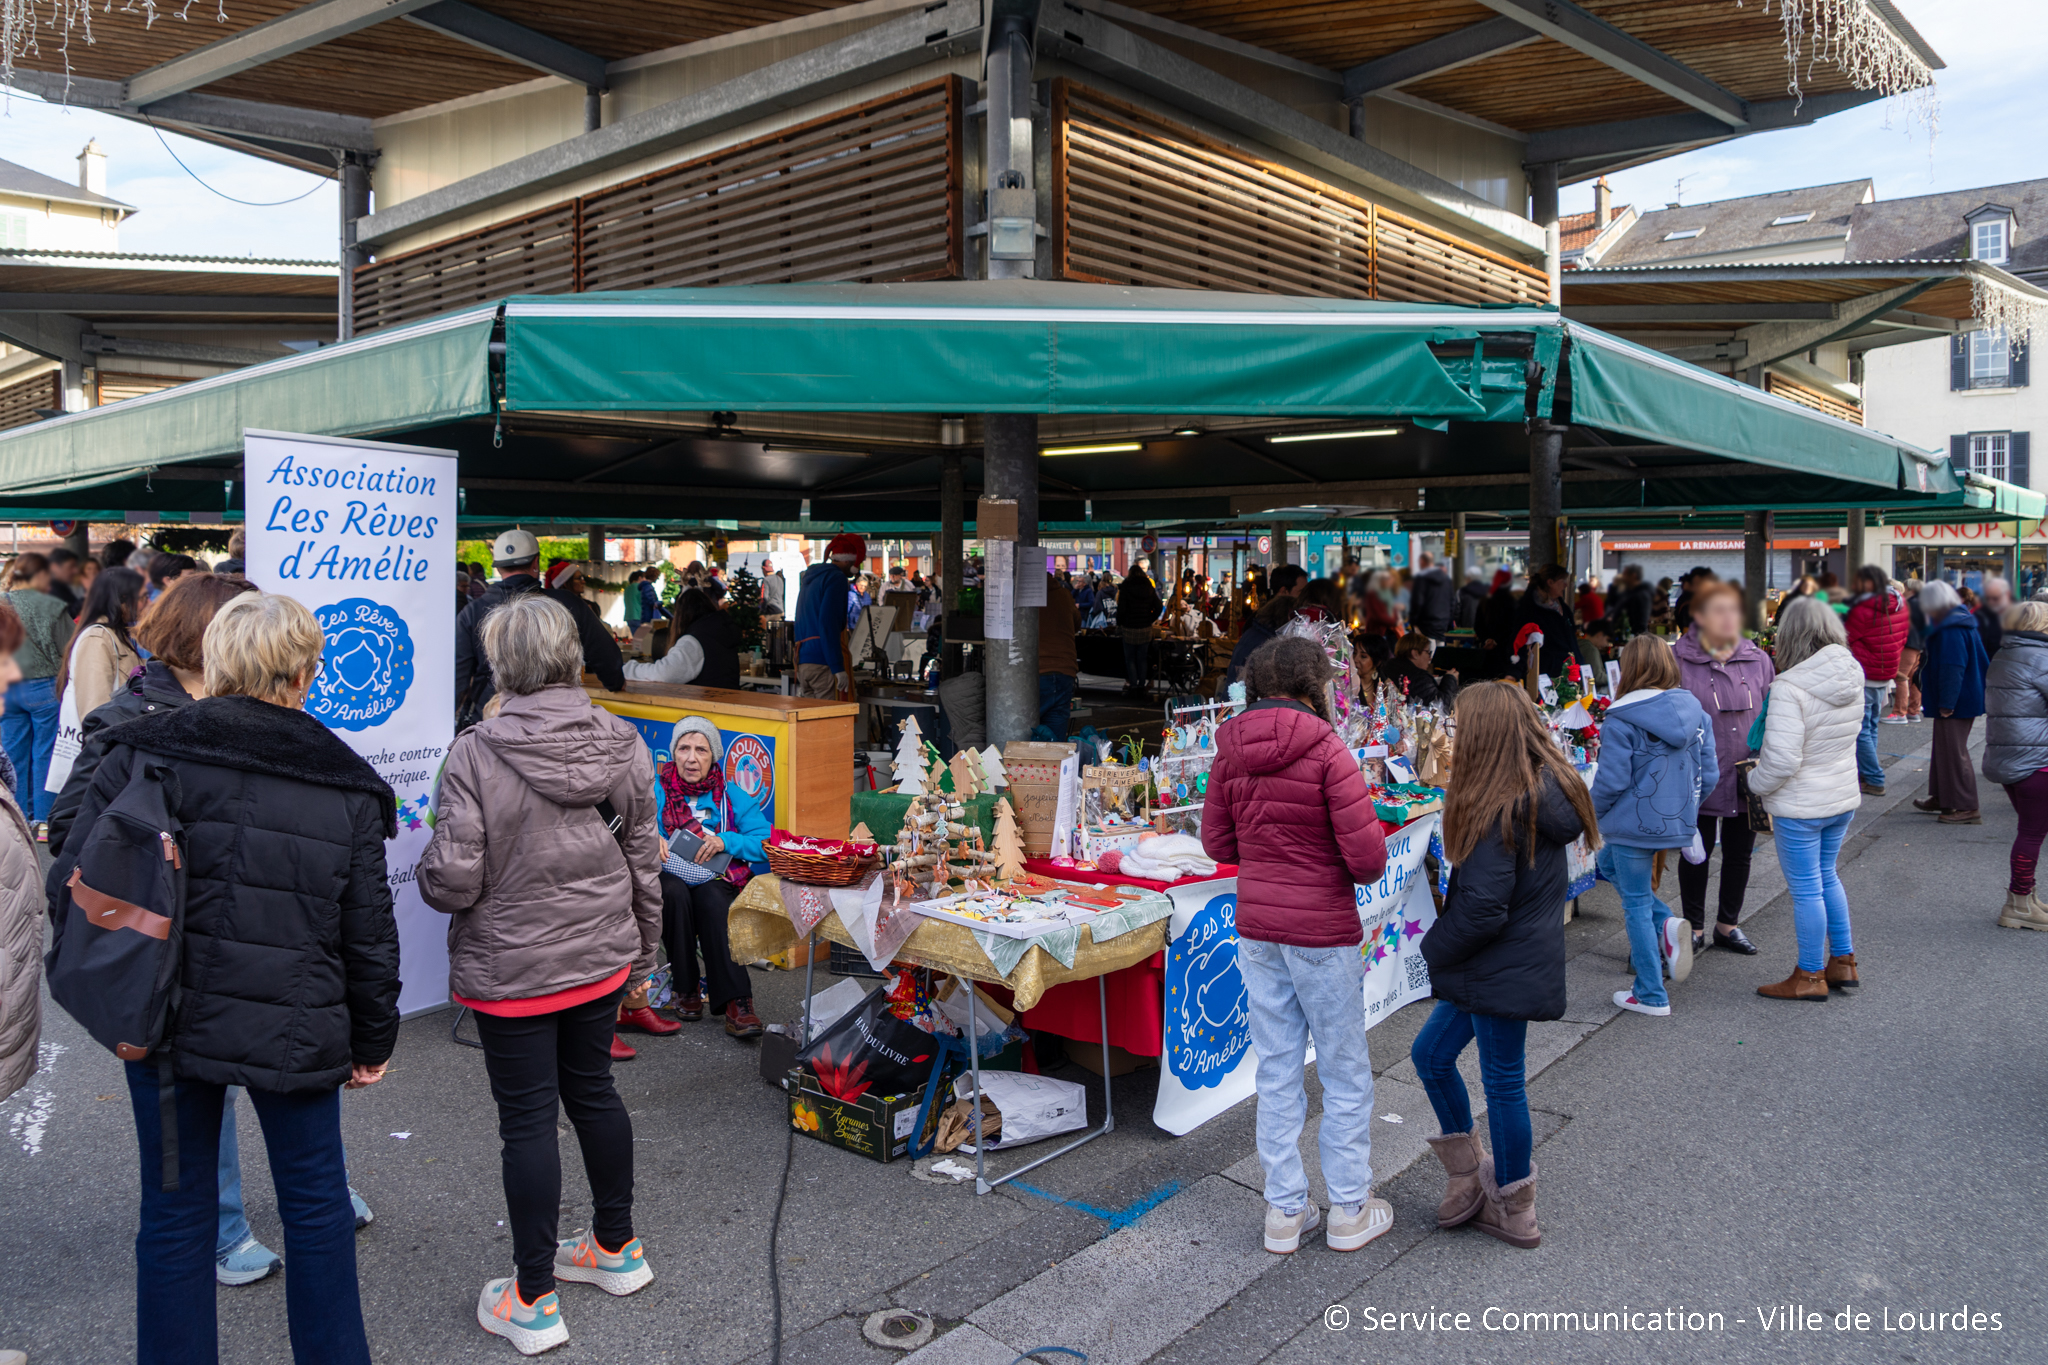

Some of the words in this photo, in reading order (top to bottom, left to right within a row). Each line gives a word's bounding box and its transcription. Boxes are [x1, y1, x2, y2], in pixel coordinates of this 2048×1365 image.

[266, 455, 436, 496] Association
[266, 495, 329, 533] Les
[340, 501, 438, 539] Rêves
[1614, 542, 1651, 550] RESTAURANT
[1680, 541, 1695, 550] LA
[1698, 541, 1745, 550] RENAISSANC
[279, 541, 428, 581] d'Amélie
[354, 605, 399, 637] Rêves
[314, 697, 396, 720] D'Amélie
[399, 747, 442, 762] contre
[730, 740, 770, 769] AOUITS
[1087, 768, 1103, 777] LES
[1106, 769, 1136, 778] REVES
[1113, 773, 1150, 786] AMELIE
[1029, 810, 1055, 822] Noël
[1187, 917, 1218, 955] Les
[865, 1034, 881, 1048] DU
[878, 1044, 909, 1066] LIVRE
[1179, 1030, 1251, 1075] D'Amélie
[828, 1106, 870, 1131] Agrumes
[834, 1121, 863, 1143] Beauté
